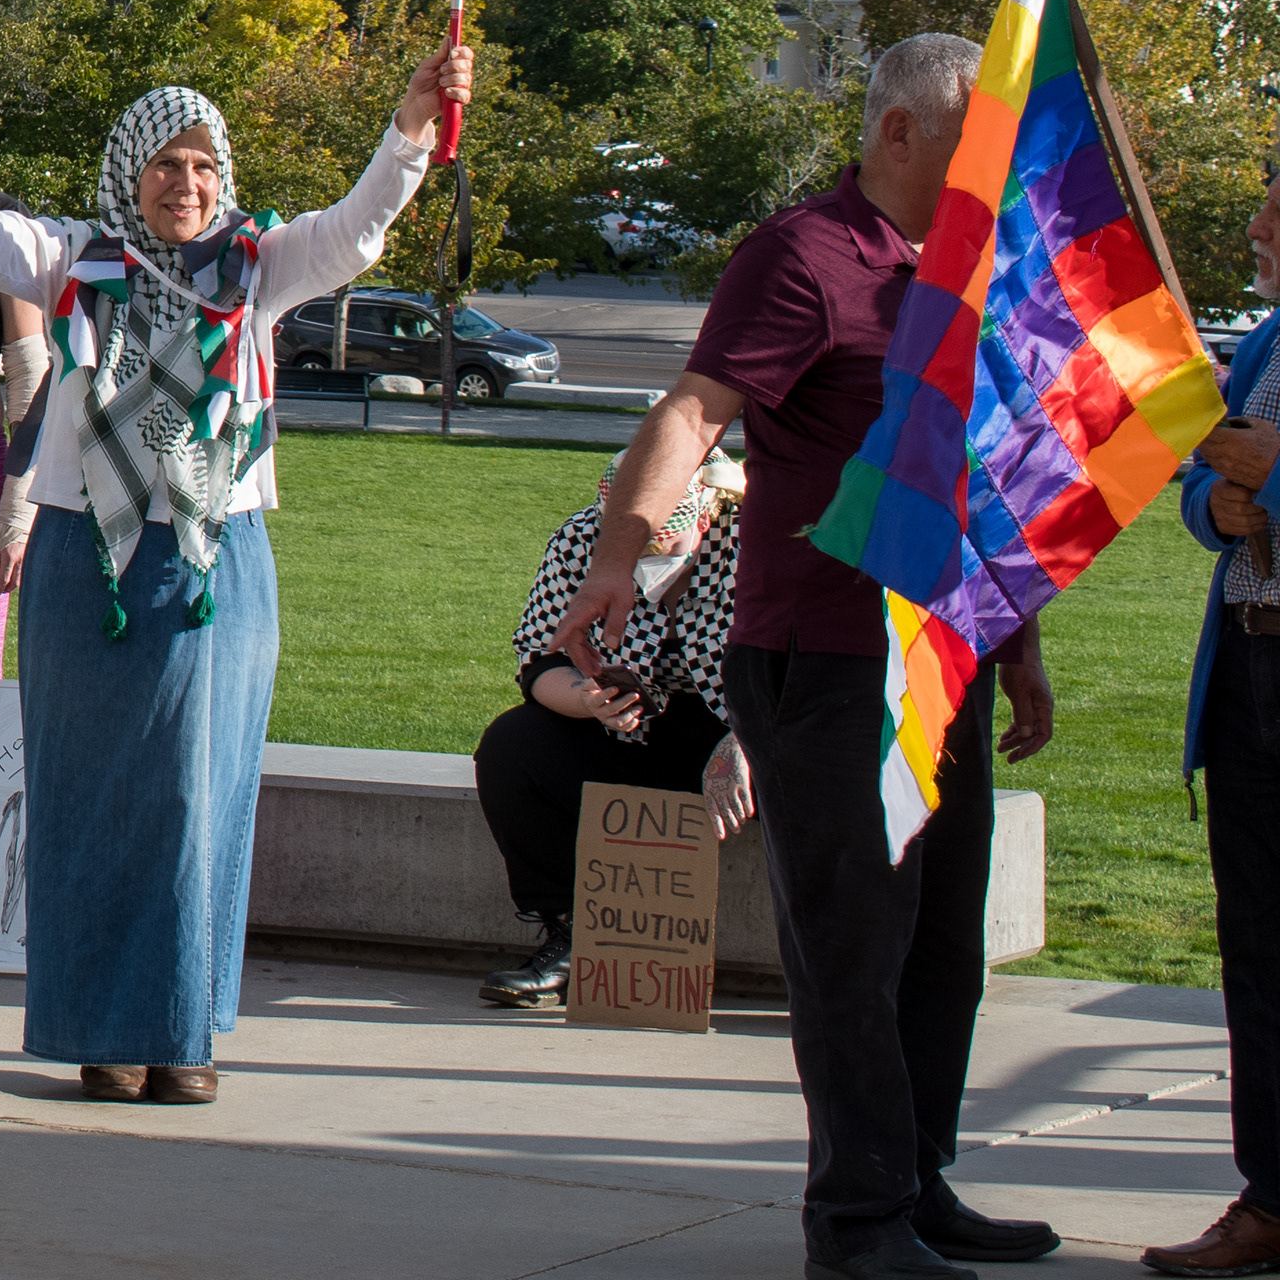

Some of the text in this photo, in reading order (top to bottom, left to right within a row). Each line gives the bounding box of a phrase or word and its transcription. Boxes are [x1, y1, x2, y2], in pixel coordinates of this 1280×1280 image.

[602, 798, 707, 842] ONE
[583, 858, 695, 899] STATE
[585, 899, 710, 946] SOLUTION
[576, 956, 714, 1014] PALESTINE
